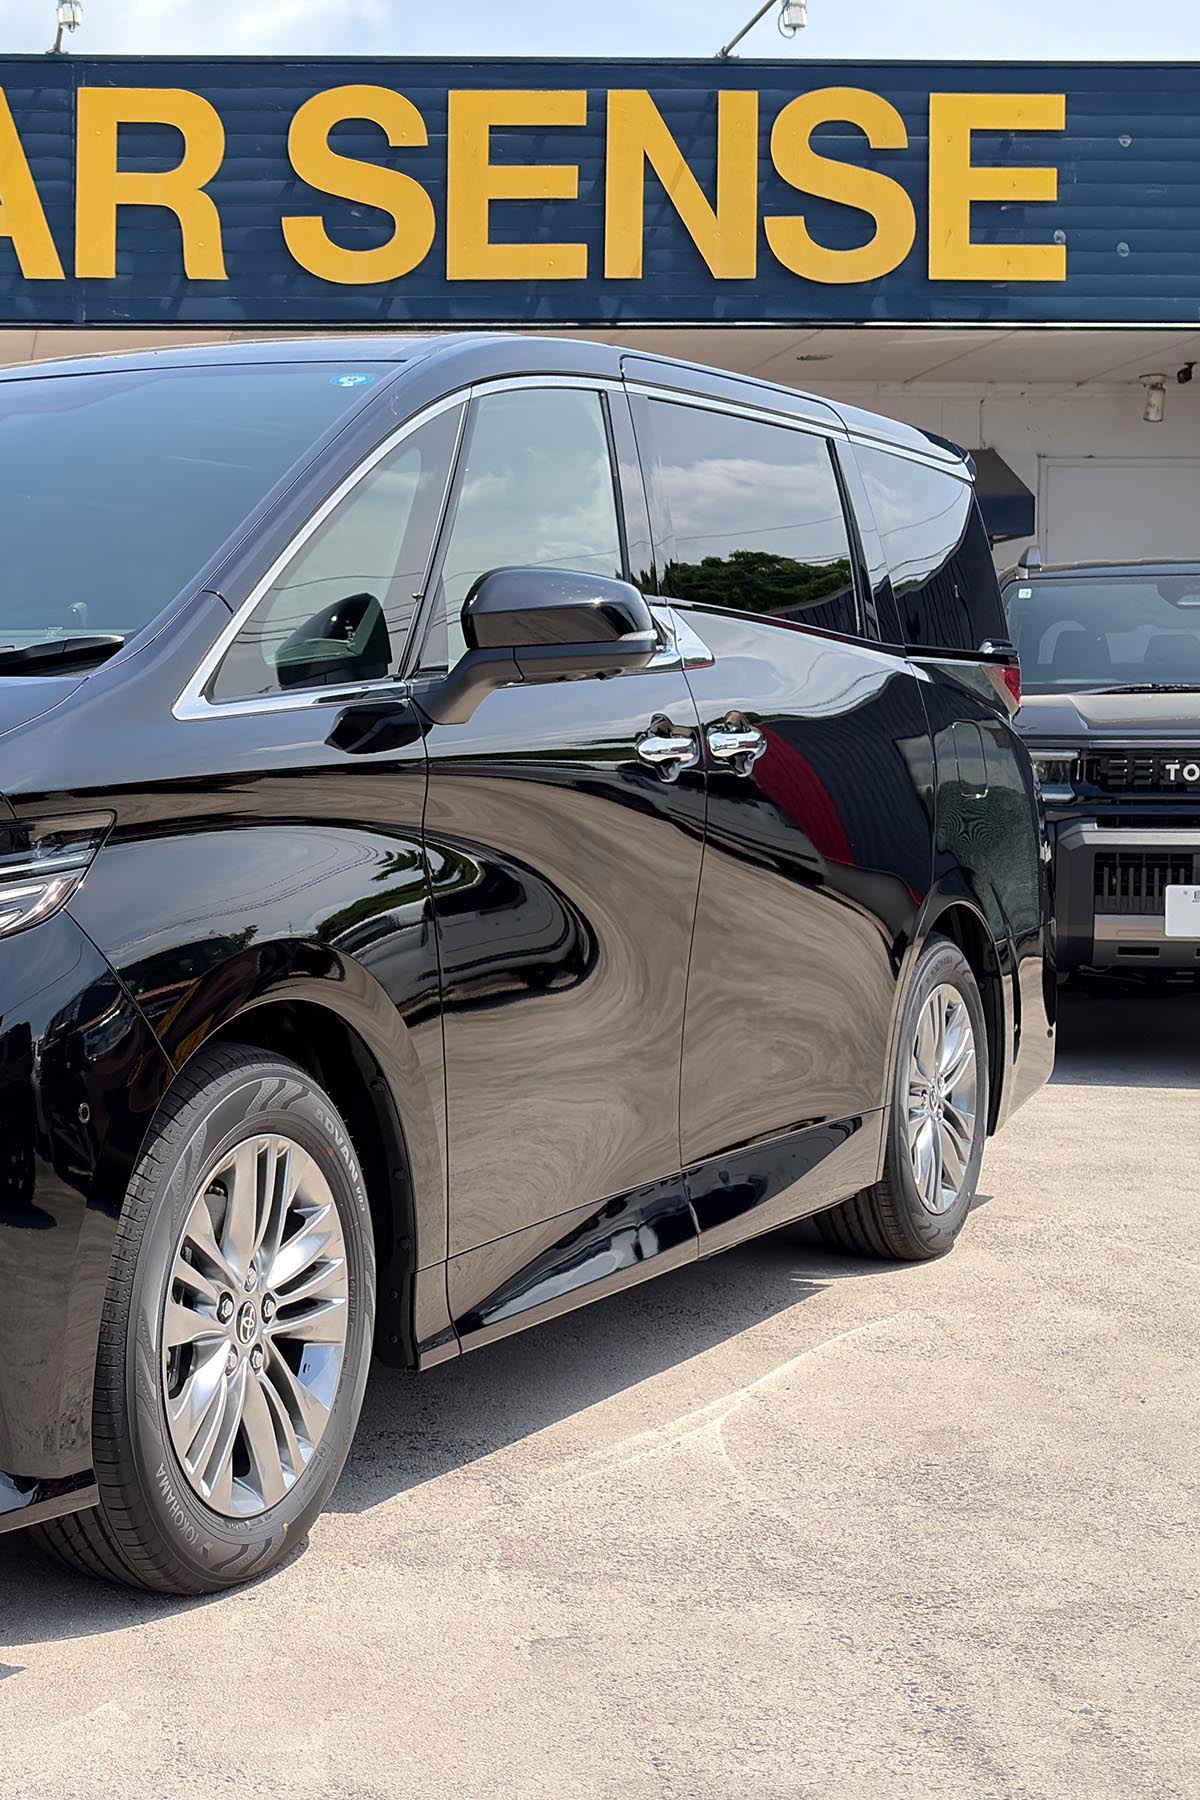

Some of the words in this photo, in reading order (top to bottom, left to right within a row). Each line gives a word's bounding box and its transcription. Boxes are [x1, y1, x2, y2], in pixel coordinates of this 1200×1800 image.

[282, 85, 1067, 285] SENSE
[1165, 763, 1200, 781] TO
[314, 1107, 359, 1183] ADVAN
[155, 1462, 200, 1546] YOKOHAMA
